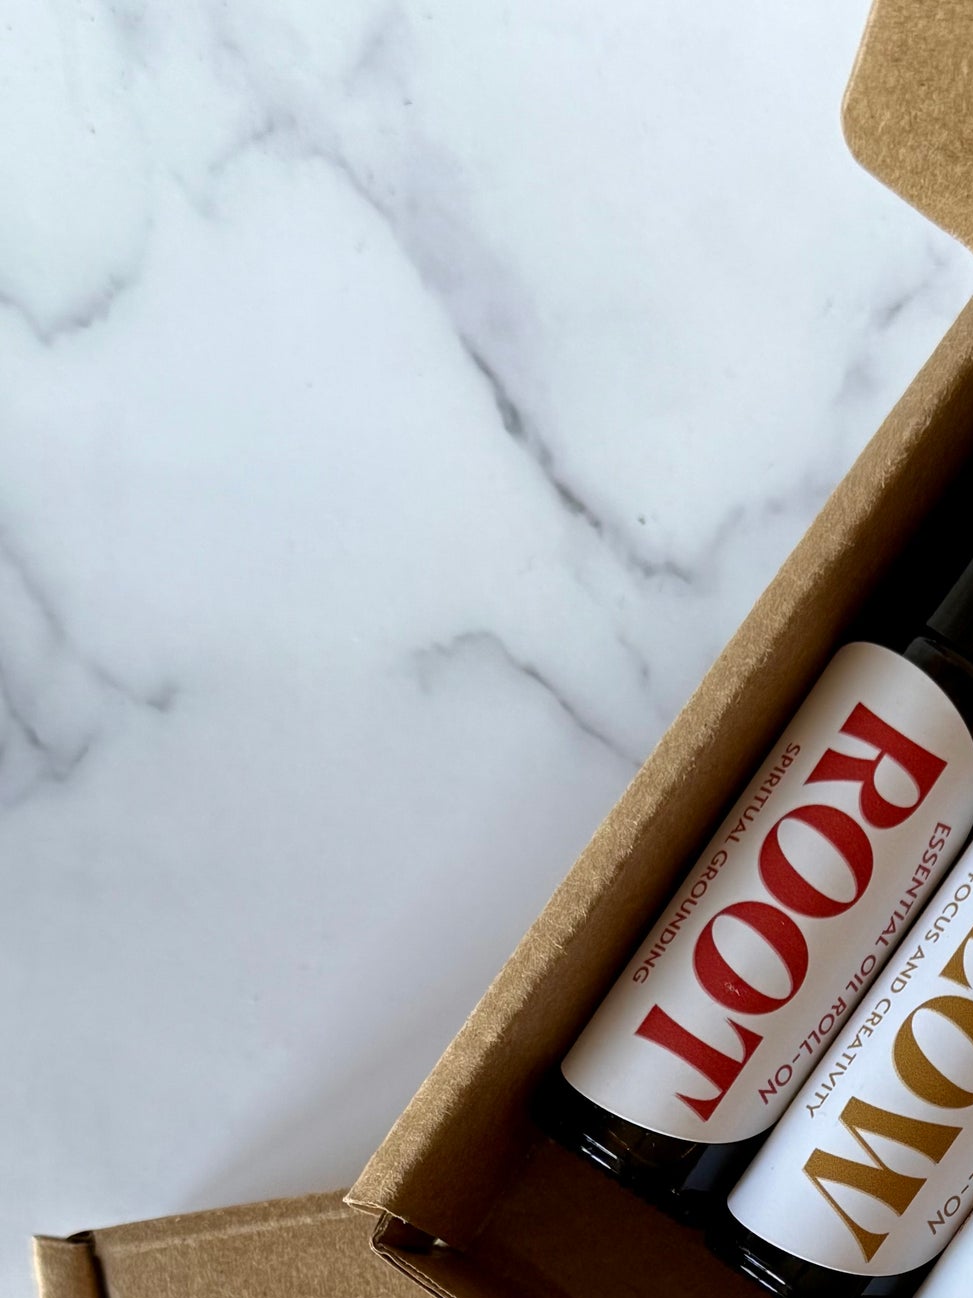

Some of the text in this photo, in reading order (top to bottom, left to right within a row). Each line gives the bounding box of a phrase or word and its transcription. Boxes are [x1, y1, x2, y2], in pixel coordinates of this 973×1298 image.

[632, 741, 802, 984] SPIRITUAL GROUNDING
[633, 701, 948, 1123] ROOT
[757, 821, 951, 1106] ESSENTIAL OIL ROLL-ON
[891, 947, 927, 994] AND
[806, 997, 892, 1118] CREATIVITY
